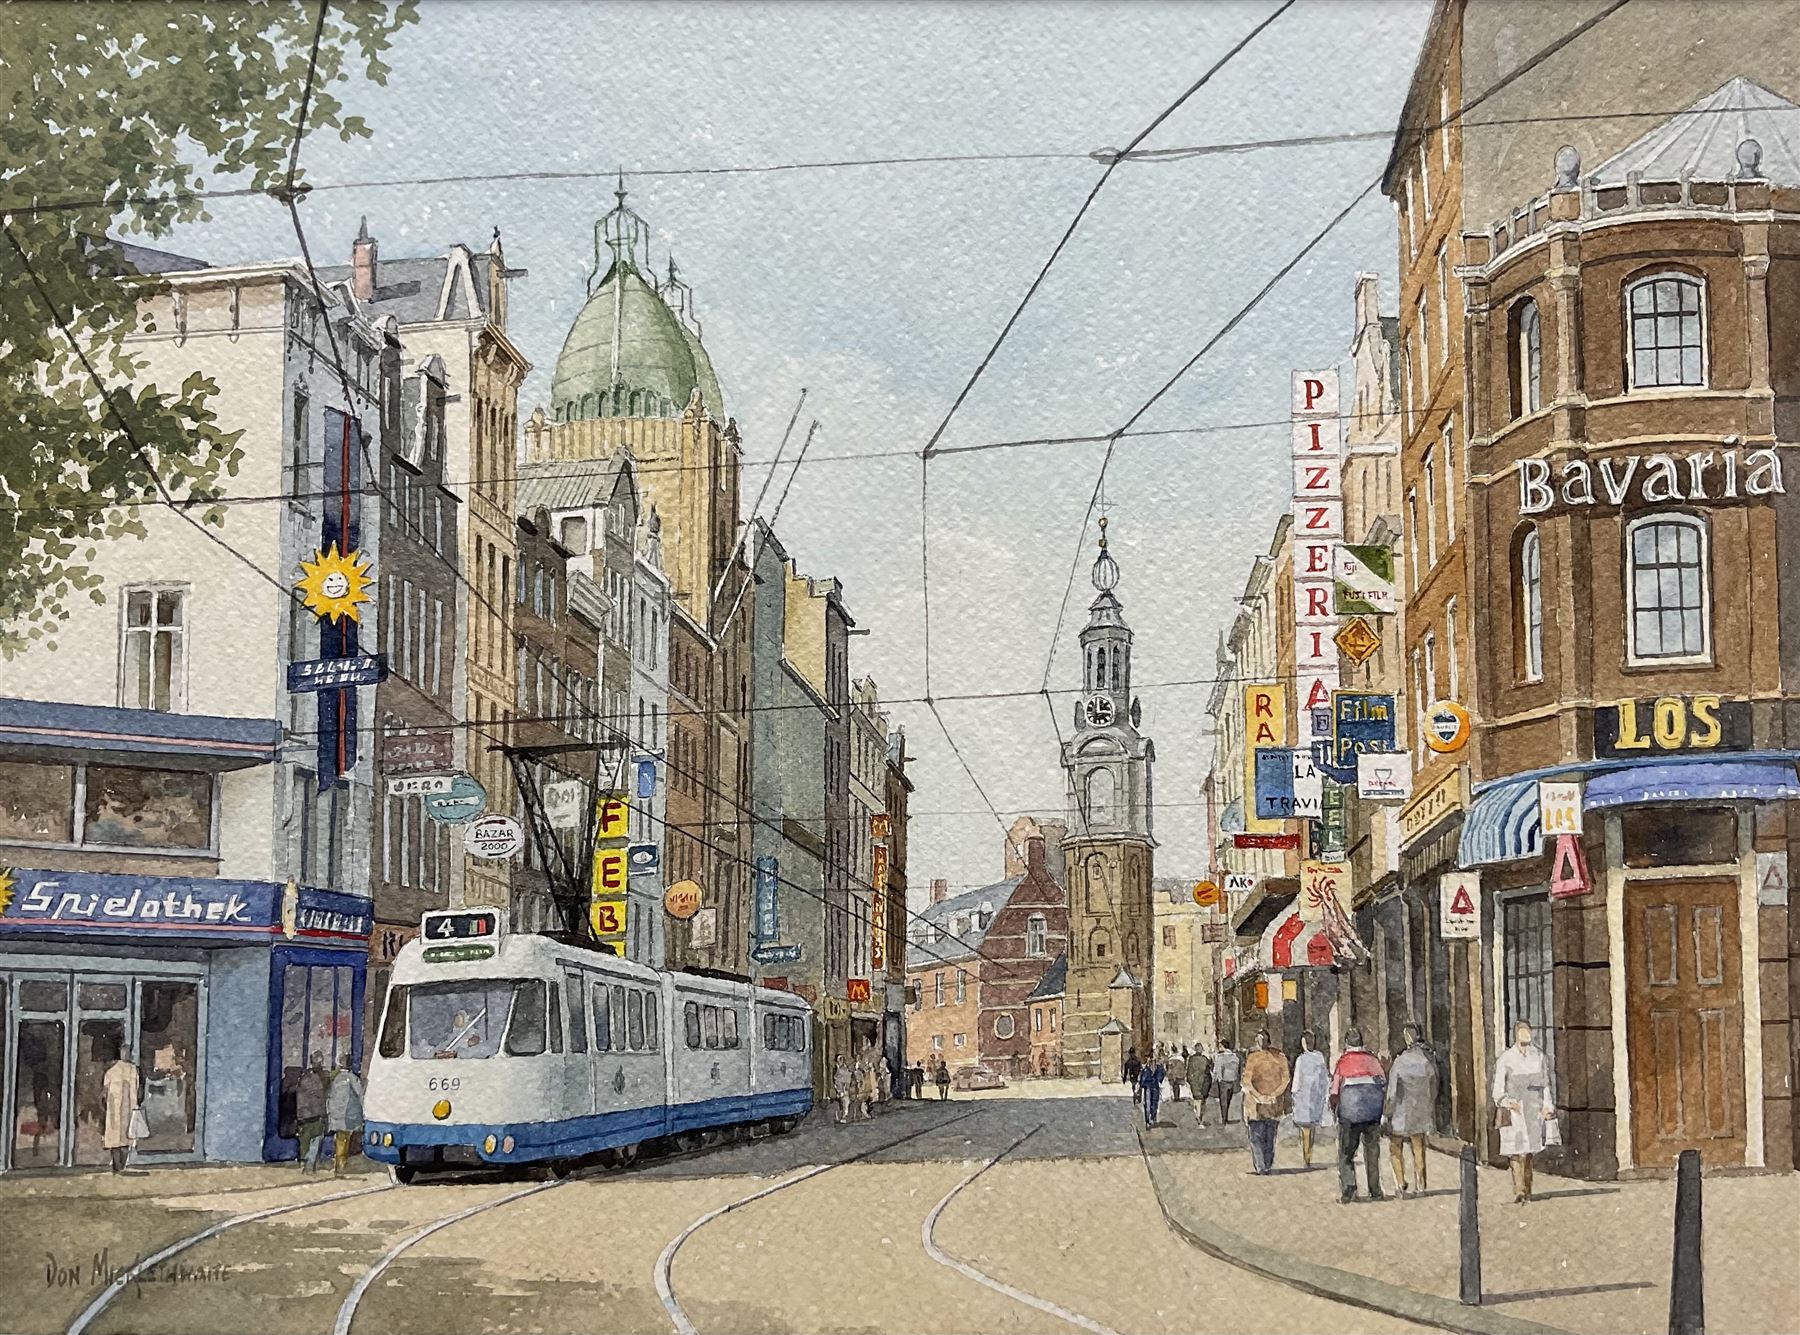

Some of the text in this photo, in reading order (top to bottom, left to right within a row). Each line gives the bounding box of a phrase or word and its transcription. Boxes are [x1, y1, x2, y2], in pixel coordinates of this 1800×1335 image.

[1517, 436, 1786, 515] Bavaria
[1303, 379, 1331, 711] PIZZERIA
[1341, 699, 1389, 721] Film
[1614, 695, 1723, 750] LOS
[1294, 765, 1316, 779] LA
[20, 881, 252, 923] Spielothek
[437, 918, 456, 938] 4
[429, 1077, 461, 1091] 669
